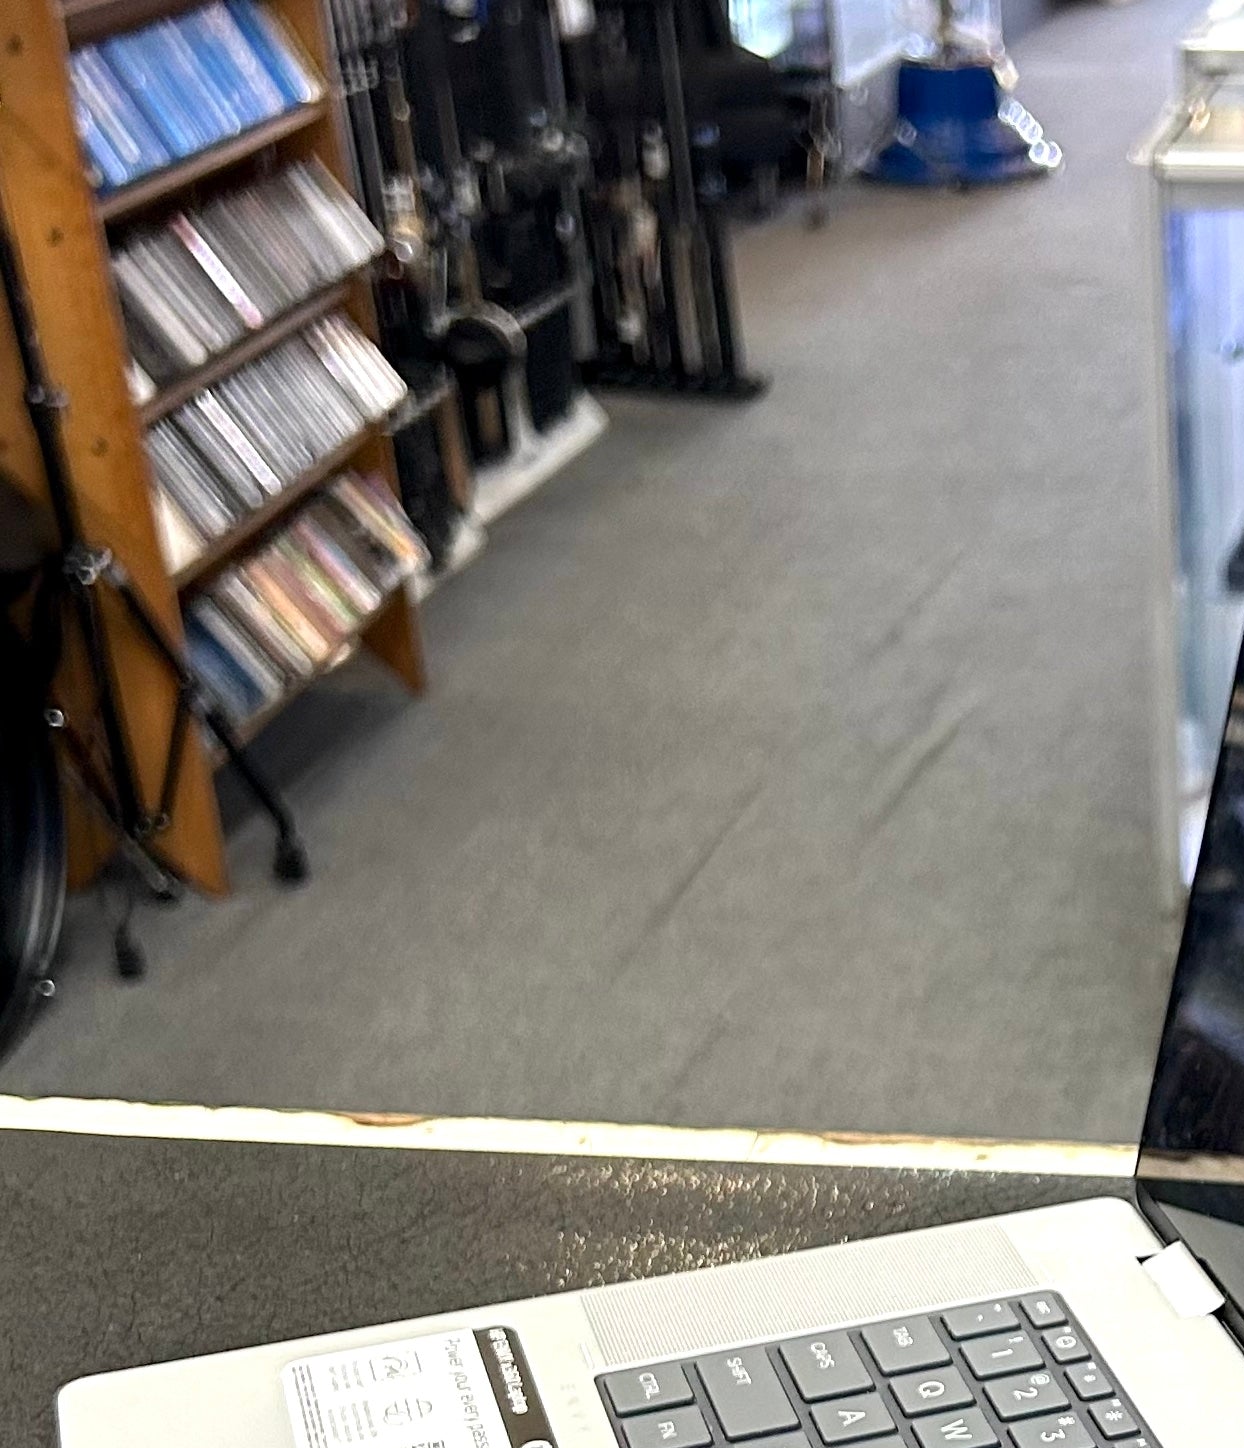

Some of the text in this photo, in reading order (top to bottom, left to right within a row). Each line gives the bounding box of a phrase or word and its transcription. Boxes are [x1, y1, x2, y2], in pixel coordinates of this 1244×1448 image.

[893, 1326, 914, 1347] TAB
[810, 1342, 835, 1369] CAPS
[726, 1357, 752, 1385] SHIFT
[1030, 1373, 1050, 1385] @
[638, 1372, 660, 1400] CTRL
[918, 1381, 945, 1399] Q
[1013, 1387, 1038, 1401] 2
[837, 1410, 866, 1427] A
[657, 1421, 677, 1440] FN
[940, 1418, 973, 1440] W
[1040, 1428, 1066, 1442] 3
